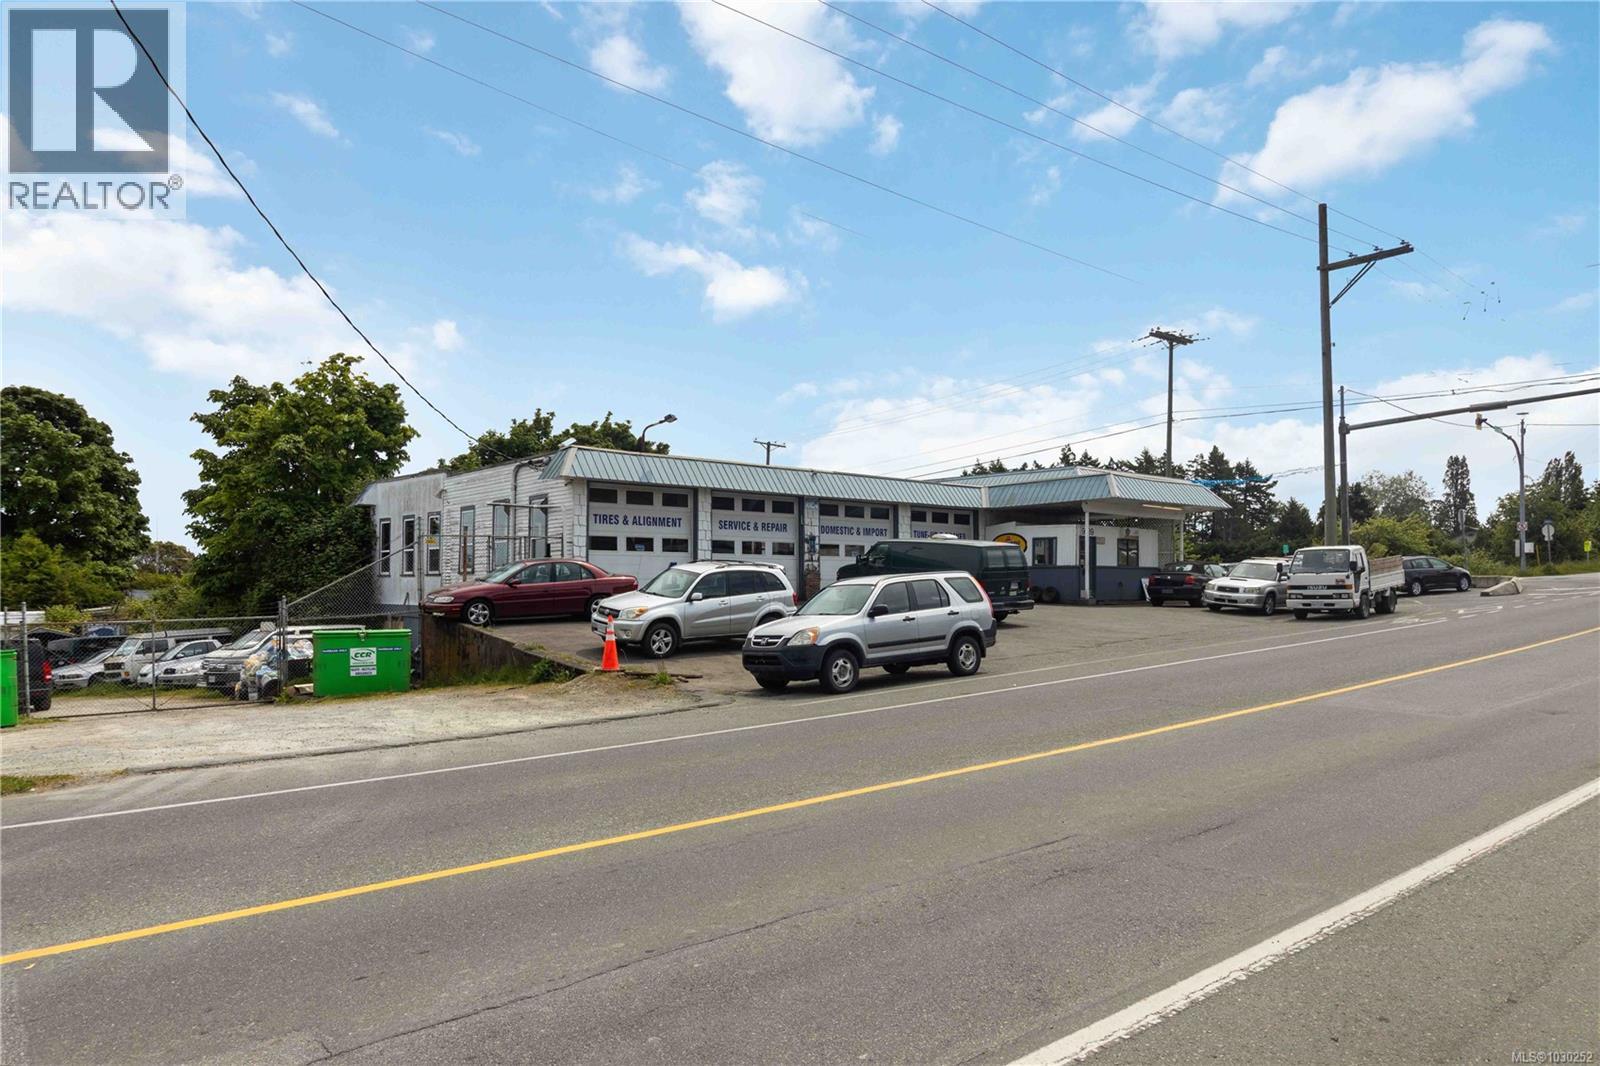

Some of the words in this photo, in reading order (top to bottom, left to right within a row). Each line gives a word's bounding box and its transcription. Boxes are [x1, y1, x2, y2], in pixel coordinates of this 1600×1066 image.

[593, 513, 619, 525] TIRES
[622, 515, 629, 526] &
[632, 516, 682, 528] ALIGNMENT
[718, 519, 751, 531] SERVICE
[753, 522, 759, 532] &
[761, 522, 788, 533] REPAIR
[820, 525, 854, 536] DOMESTIC
[855, 527, 861, 536] &
[863, 527, 888, 537] IMPORT
